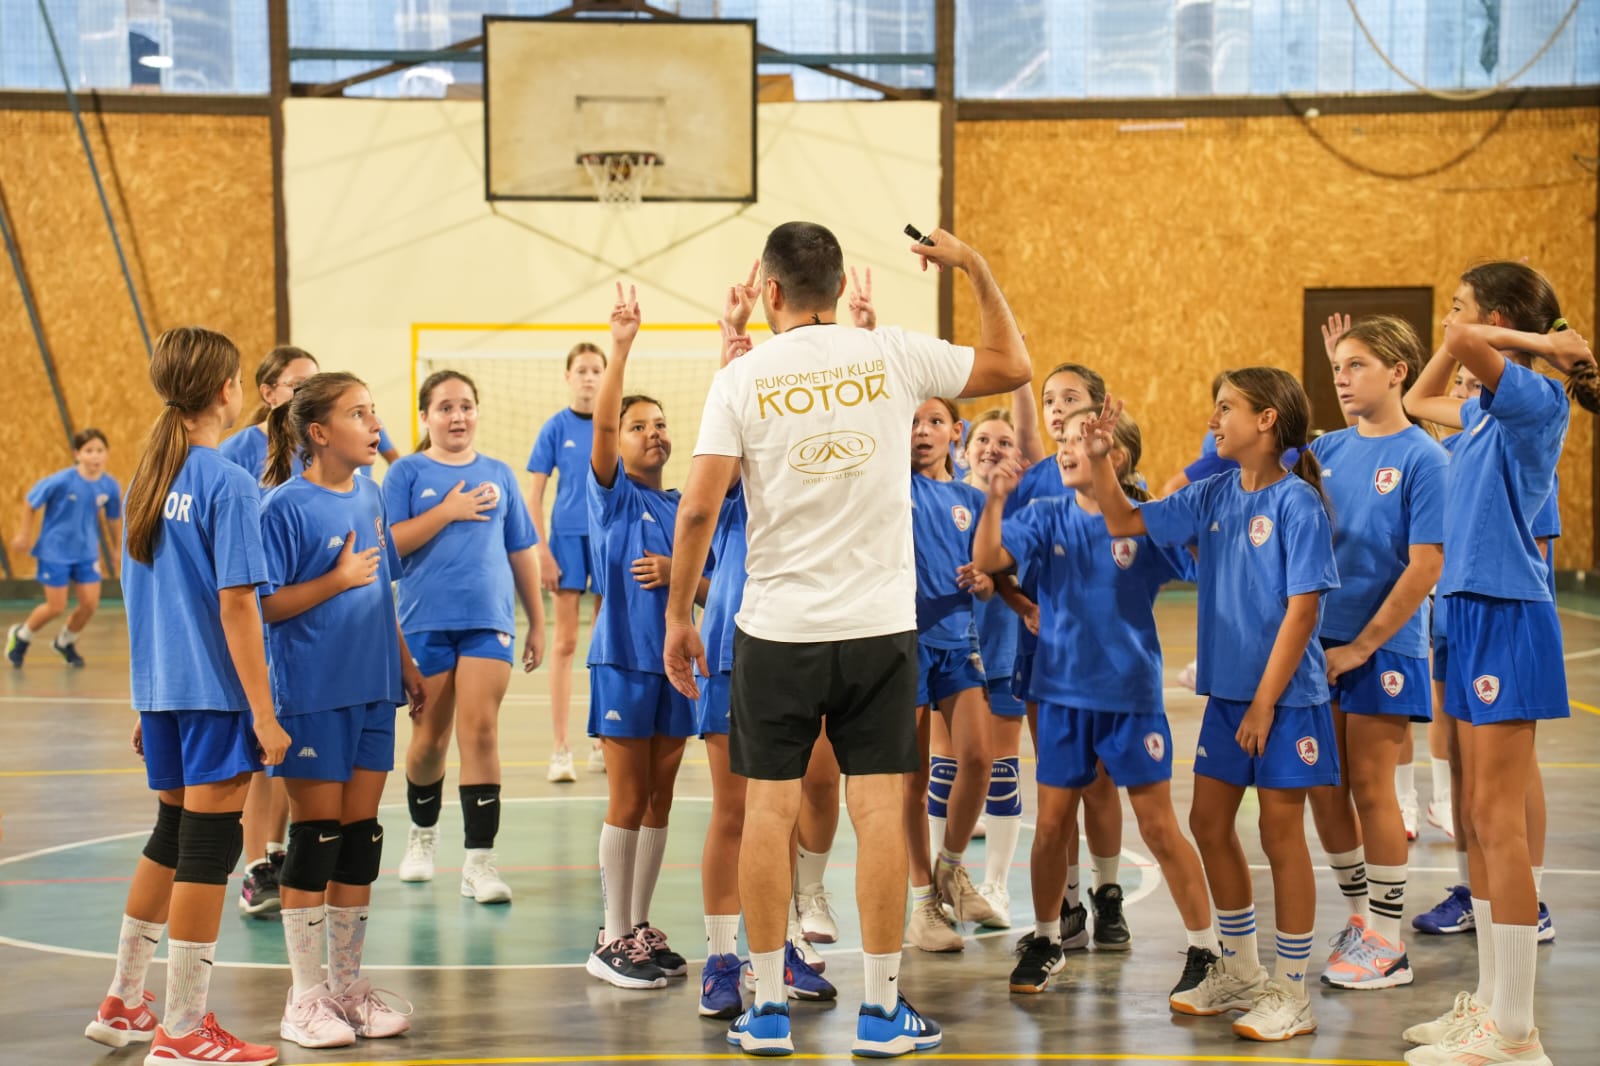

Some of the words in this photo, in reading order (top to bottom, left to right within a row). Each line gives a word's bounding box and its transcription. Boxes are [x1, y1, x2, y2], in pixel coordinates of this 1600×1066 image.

[755, 367, 844, 390] RUKOMETNI
[847, 359, 885, 376] KLUB
[757, 373, 890, 420] KOTOR
